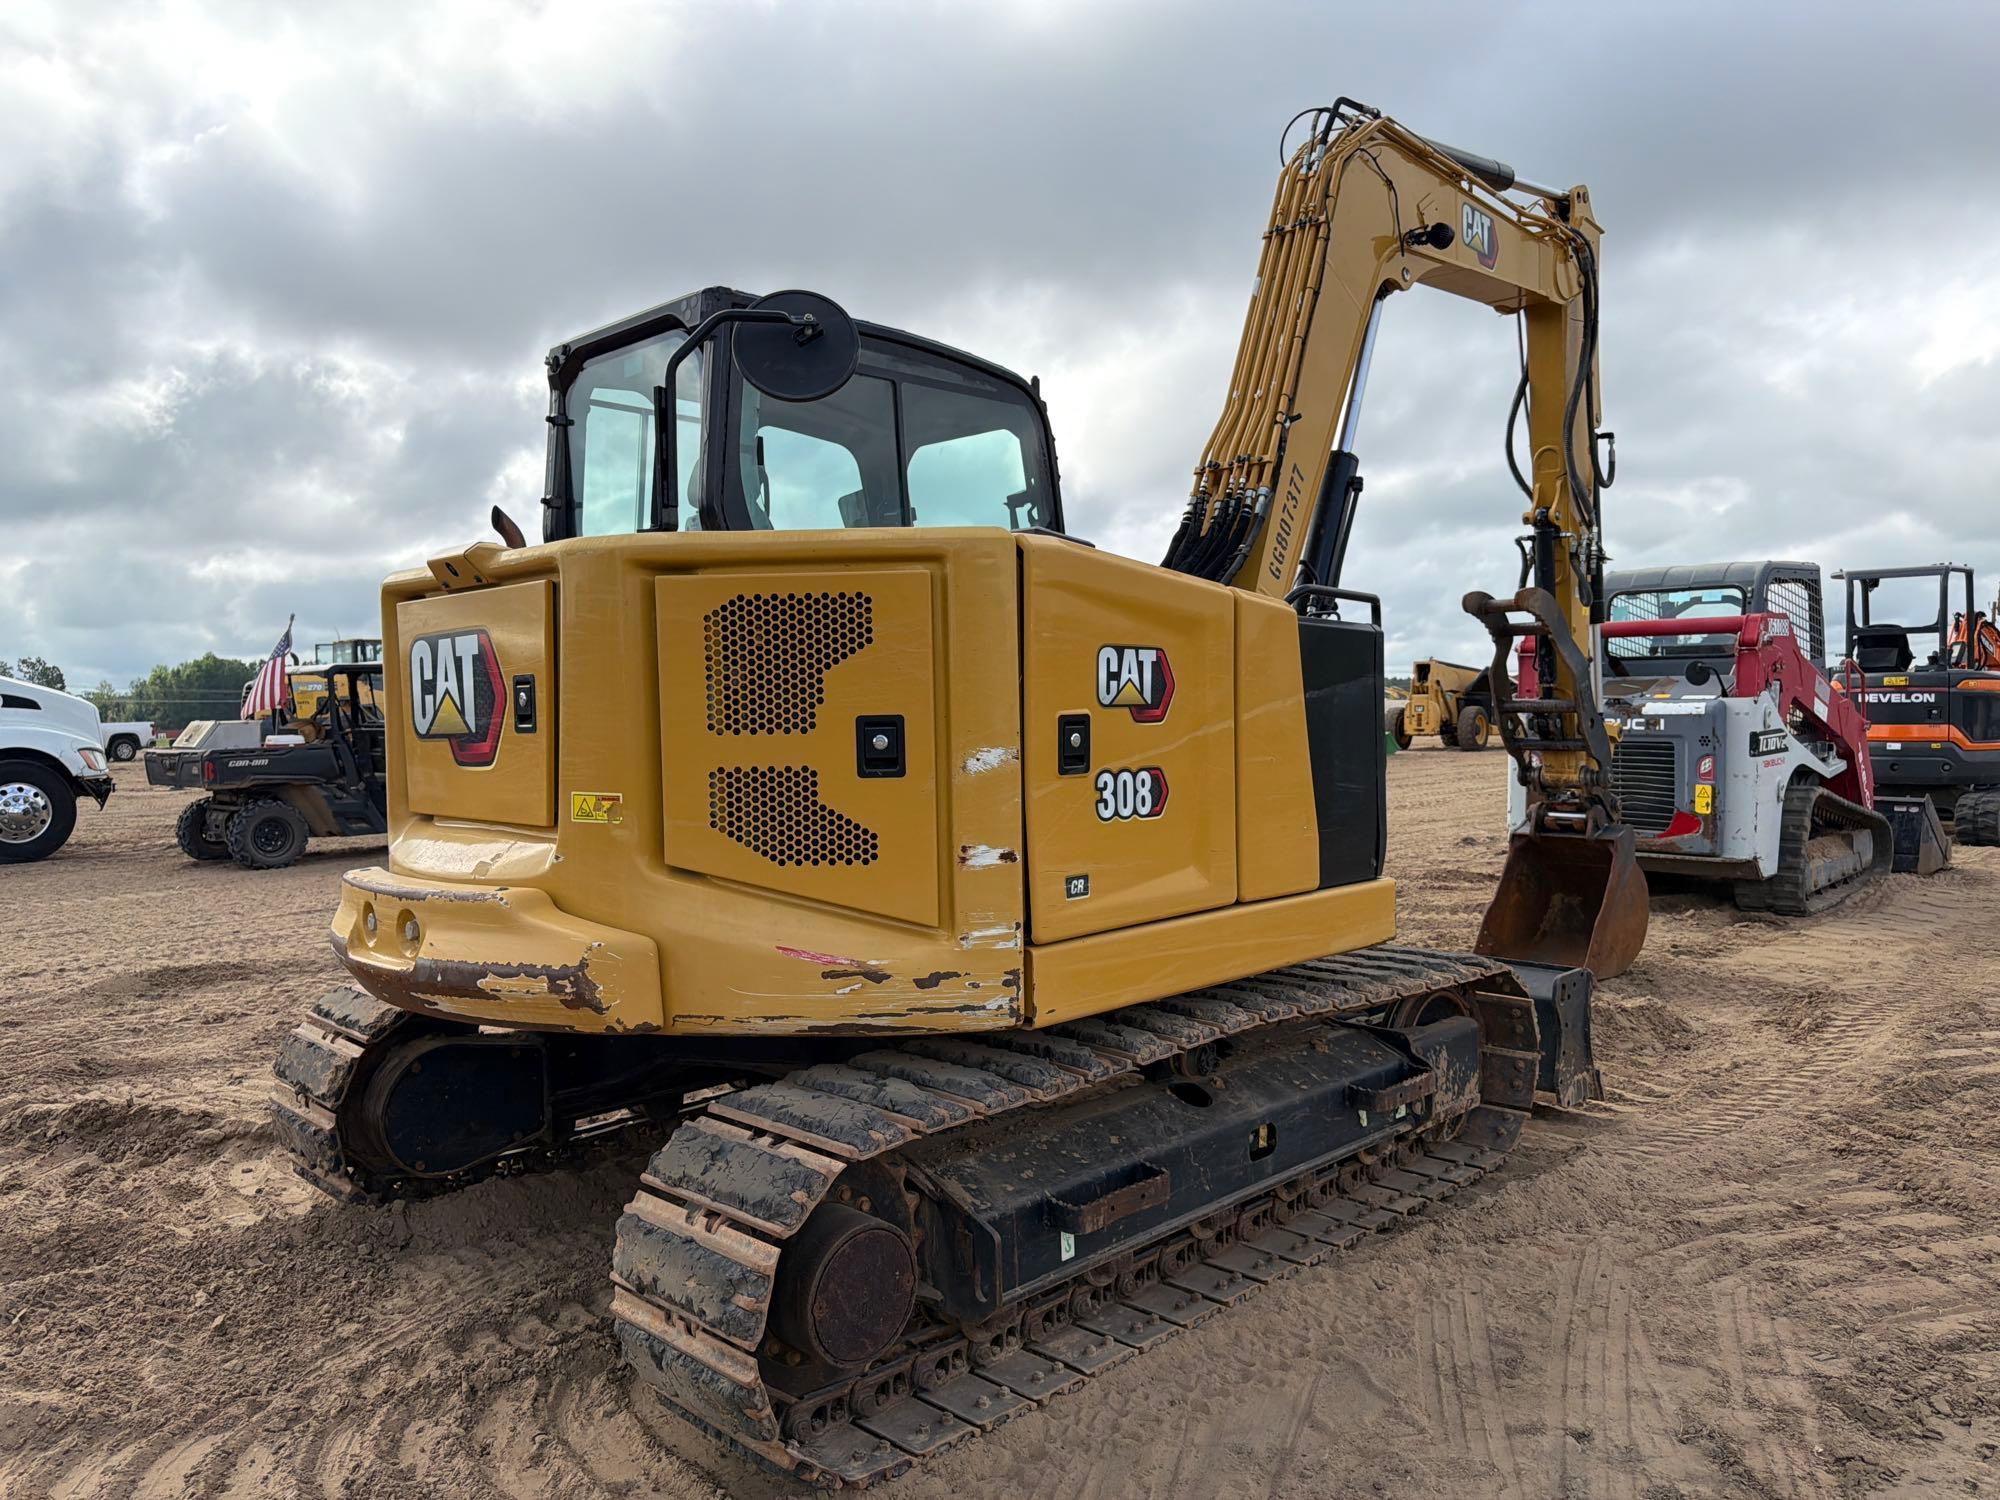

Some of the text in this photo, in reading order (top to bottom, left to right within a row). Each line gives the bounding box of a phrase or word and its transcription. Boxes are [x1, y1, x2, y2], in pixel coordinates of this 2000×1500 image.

[1462, 204, 1491, 256] CAT
[411, 634, 479, 735] CAT
[1099, 646, 1157, 705] CAT
[1858, 693, 1936, 703] DEVELON
[1097, 771, 1152, 819] 308
[1071, 879, 1085, 894] CR
